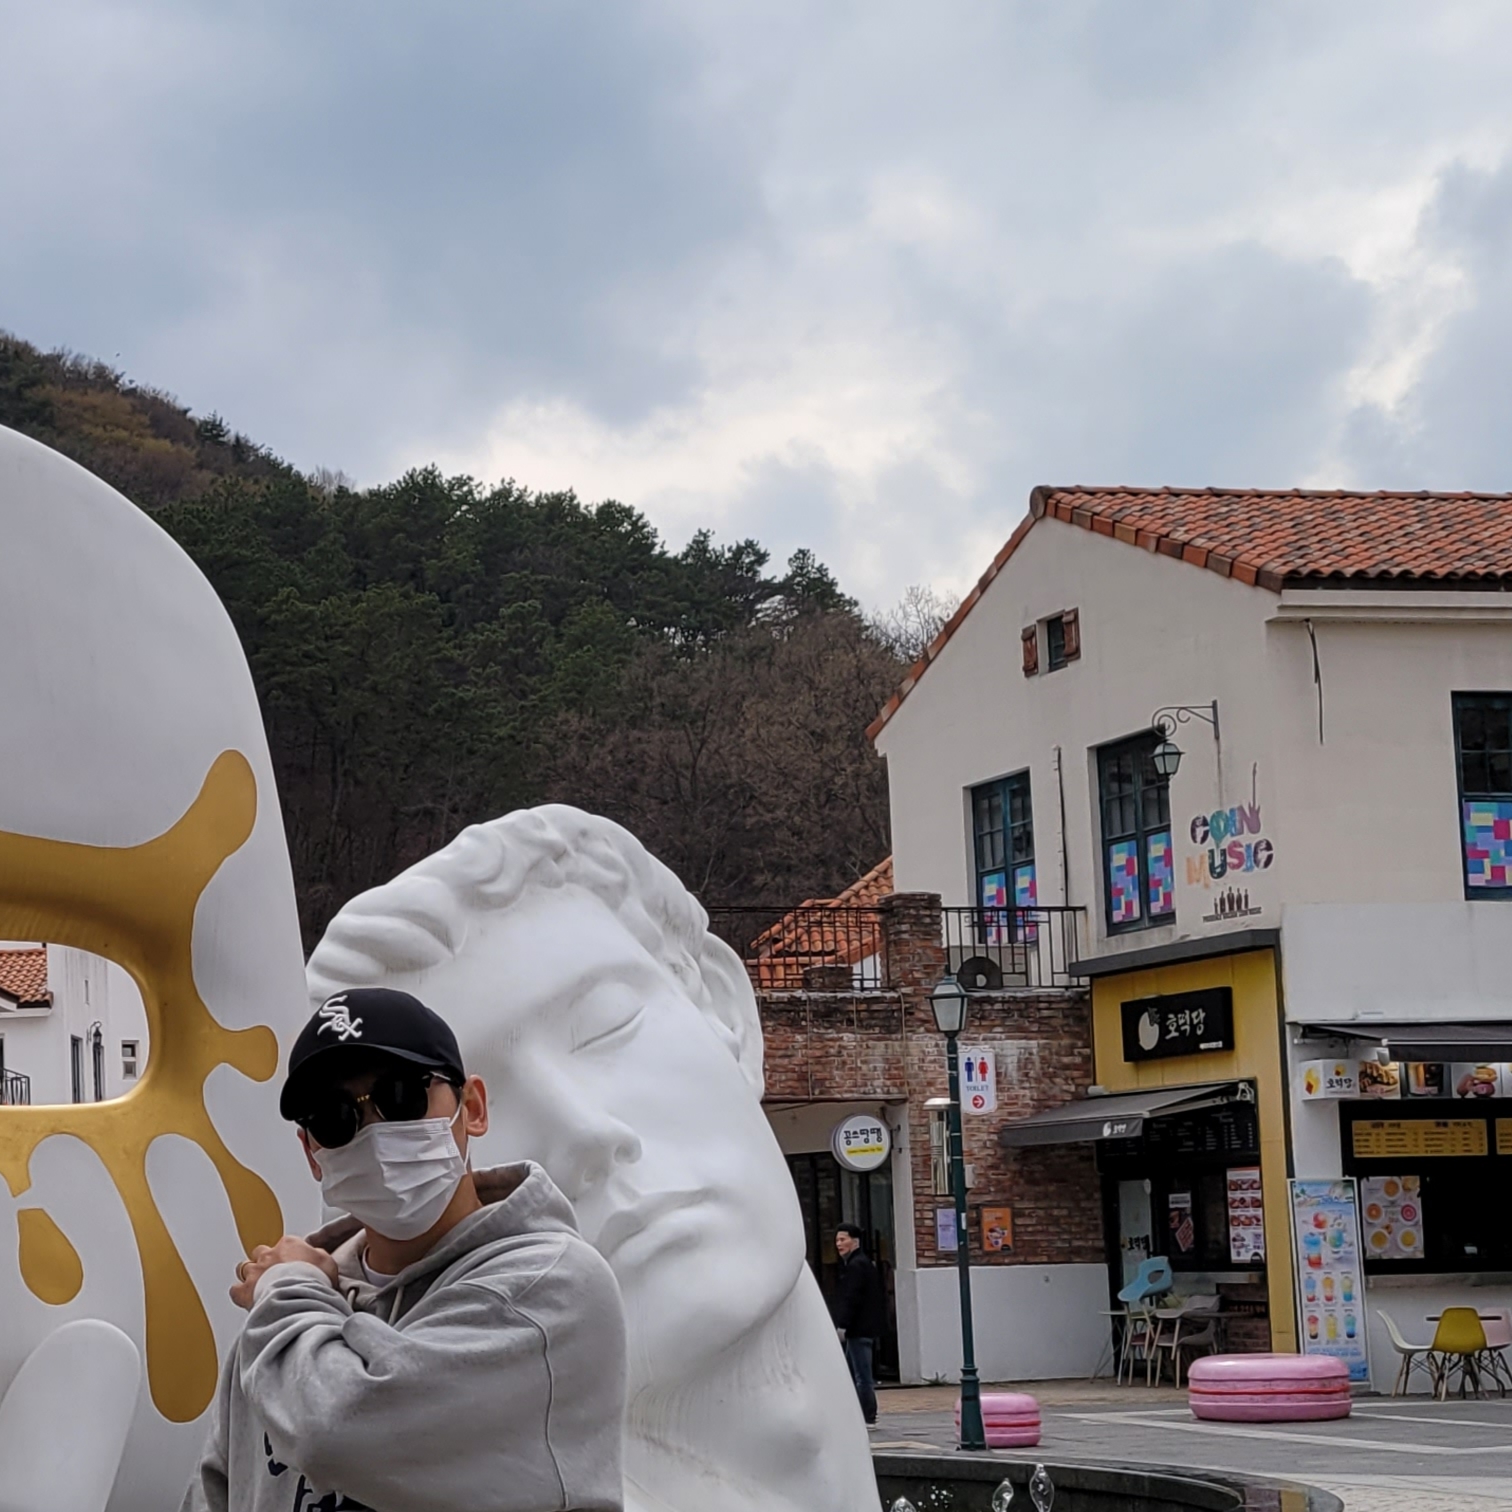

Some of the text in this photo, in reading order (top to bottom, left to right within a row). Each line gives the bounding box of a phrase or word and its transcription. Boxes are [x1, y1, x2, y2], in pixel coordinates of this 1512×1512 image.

[1190, 804, 1261, 846] COIN
[1186, 838, 1274, 889] MUSIC
[1165, 1008, 1206, 1039] 호떡당
[965, 1084, 990, 1093] TOILET
